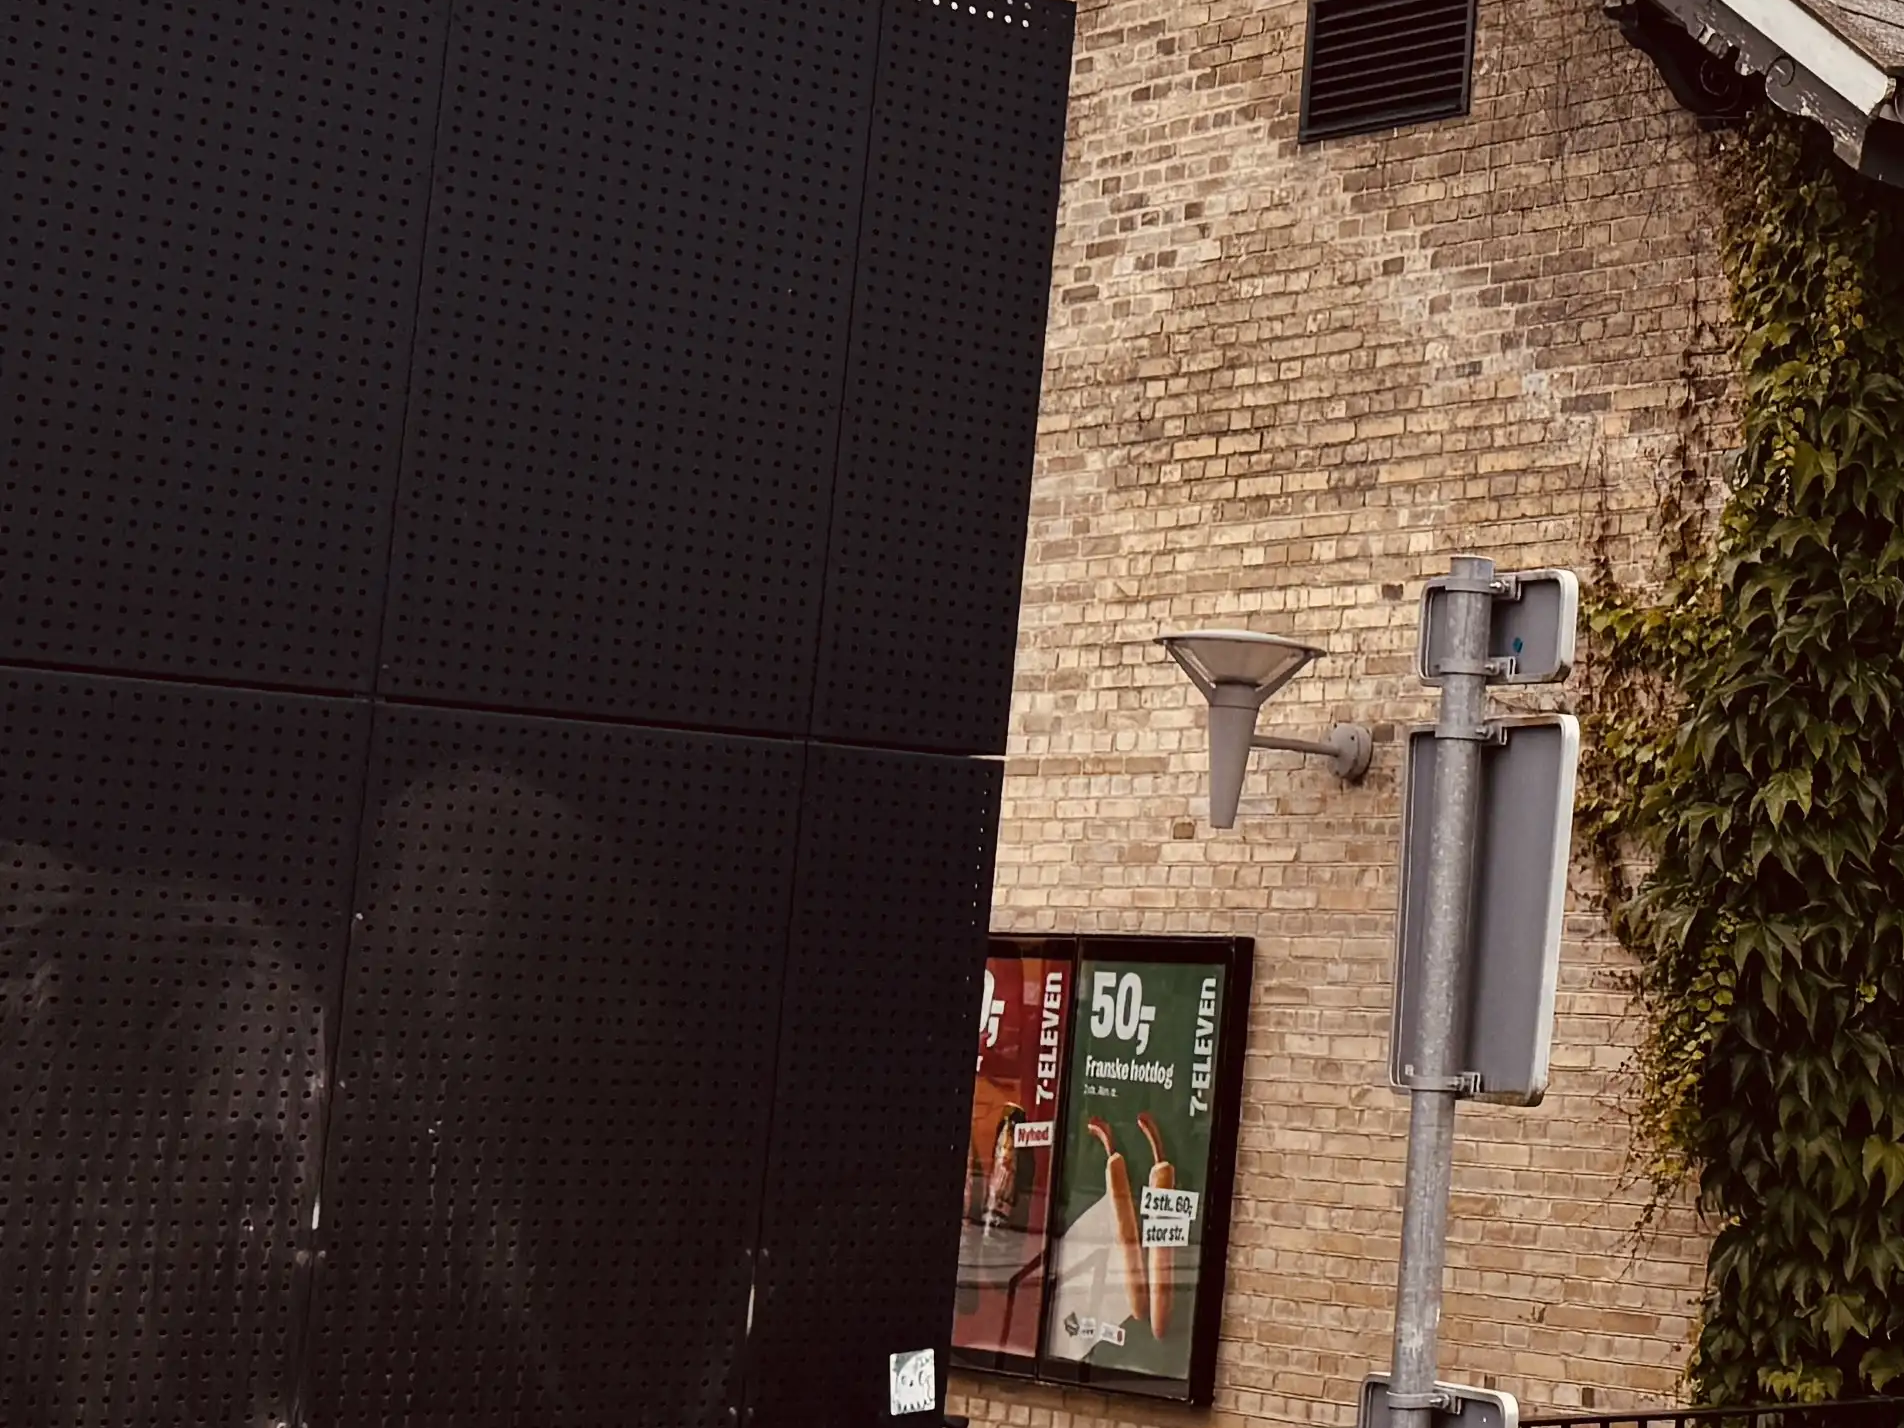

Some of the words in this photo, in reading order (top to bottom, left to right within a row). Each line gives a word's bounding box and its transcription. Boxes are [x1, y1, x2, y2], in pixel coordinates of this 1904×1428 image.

[1085, 1055, 1129, 1081] Franske
[1129, 1058, 1174, 1090] hotdog
[1017, 1126, 1049, 1146] Nyhed
[1144, 1193, 1152, 1209] 2
[1152, 1196, 1174, 1213] stk.
[1145, 1225, 1167, 1242] stor
[1168, 1228, 1186, 1242] str.
